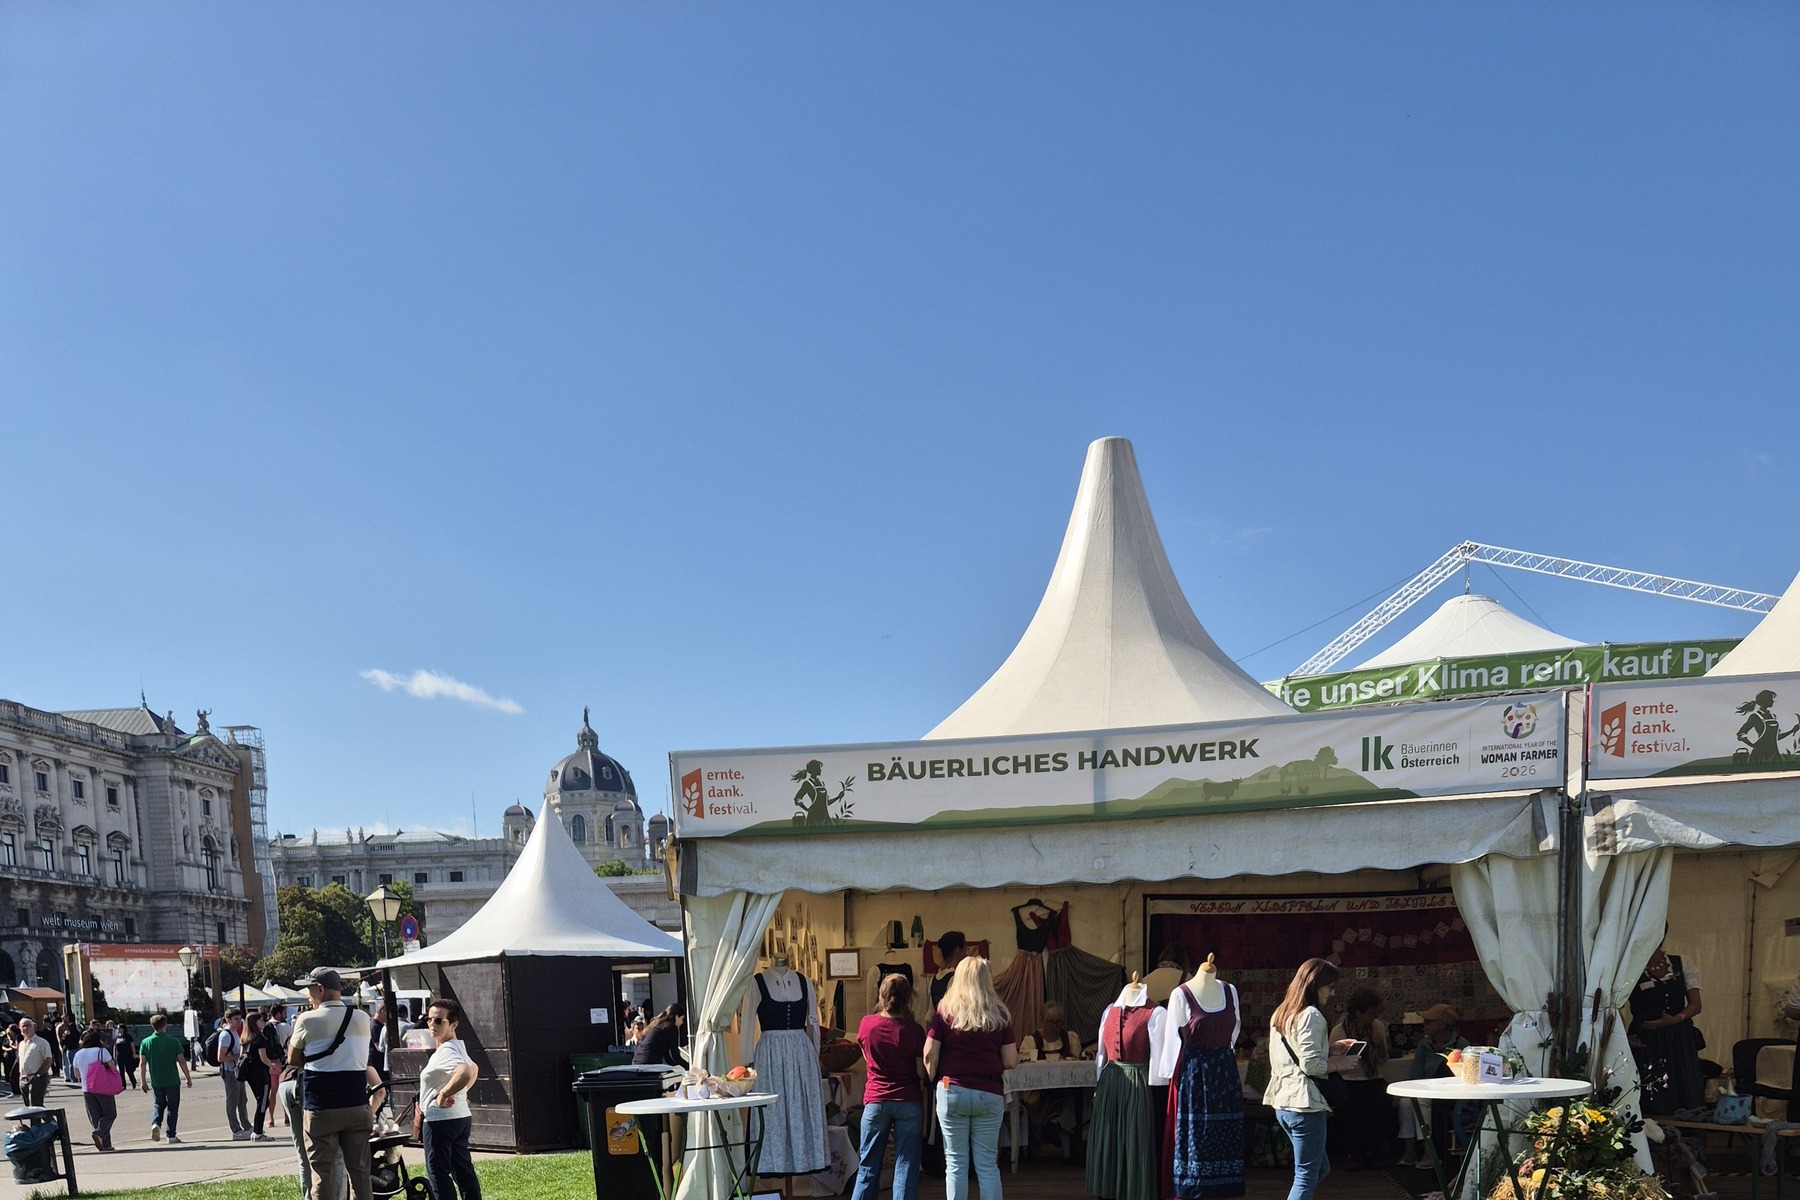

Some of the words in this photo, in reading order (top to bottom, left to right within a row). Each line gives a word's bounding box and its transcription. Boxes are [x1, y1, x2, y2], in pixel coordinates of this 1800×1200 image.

[1321, 675, 1409, 704] unser
[1418, 663, 1509, 692] Klima
[1520, 655, 1590, 686] rein,
[1602, 648, 1672, 677] kauf
[1632, 701, 1679, 715] ernte.
[1631, 720, 1675, 735] dank.
[1401, 741, 1458, 754] Bäuerinnen
[1482, 742, 1523, 752] INTERNATIONAL
[1524, 741, 1538, 749] YEAR
[1546, 739, 1557, 747] THE
[1631, 738, 1690, 753] festival.
[867, 751, 1069, 782] BÄUERLICHES
[1078, 738, 1261, 770] HANDWERK
[1401, 754, 1460, 769] Österreich
[1481, 751, 1517, 764] WOMAN
[1520, 748, 1558, 761] FARMER
[707, 768, 745, 780] ernte.
[1501, 764, 1537, 778] 2026
[708, 785, 744, 798] dank.
[708, 801, 758, 815] festival.
[1346, 899, 1380, 911] UND
[1386, 895, 1447, 910] TEXTILE
[42, 914, 61, 927] welt
[64, 917, 98, 929] museum
[100, 918, 119, 931] wien
